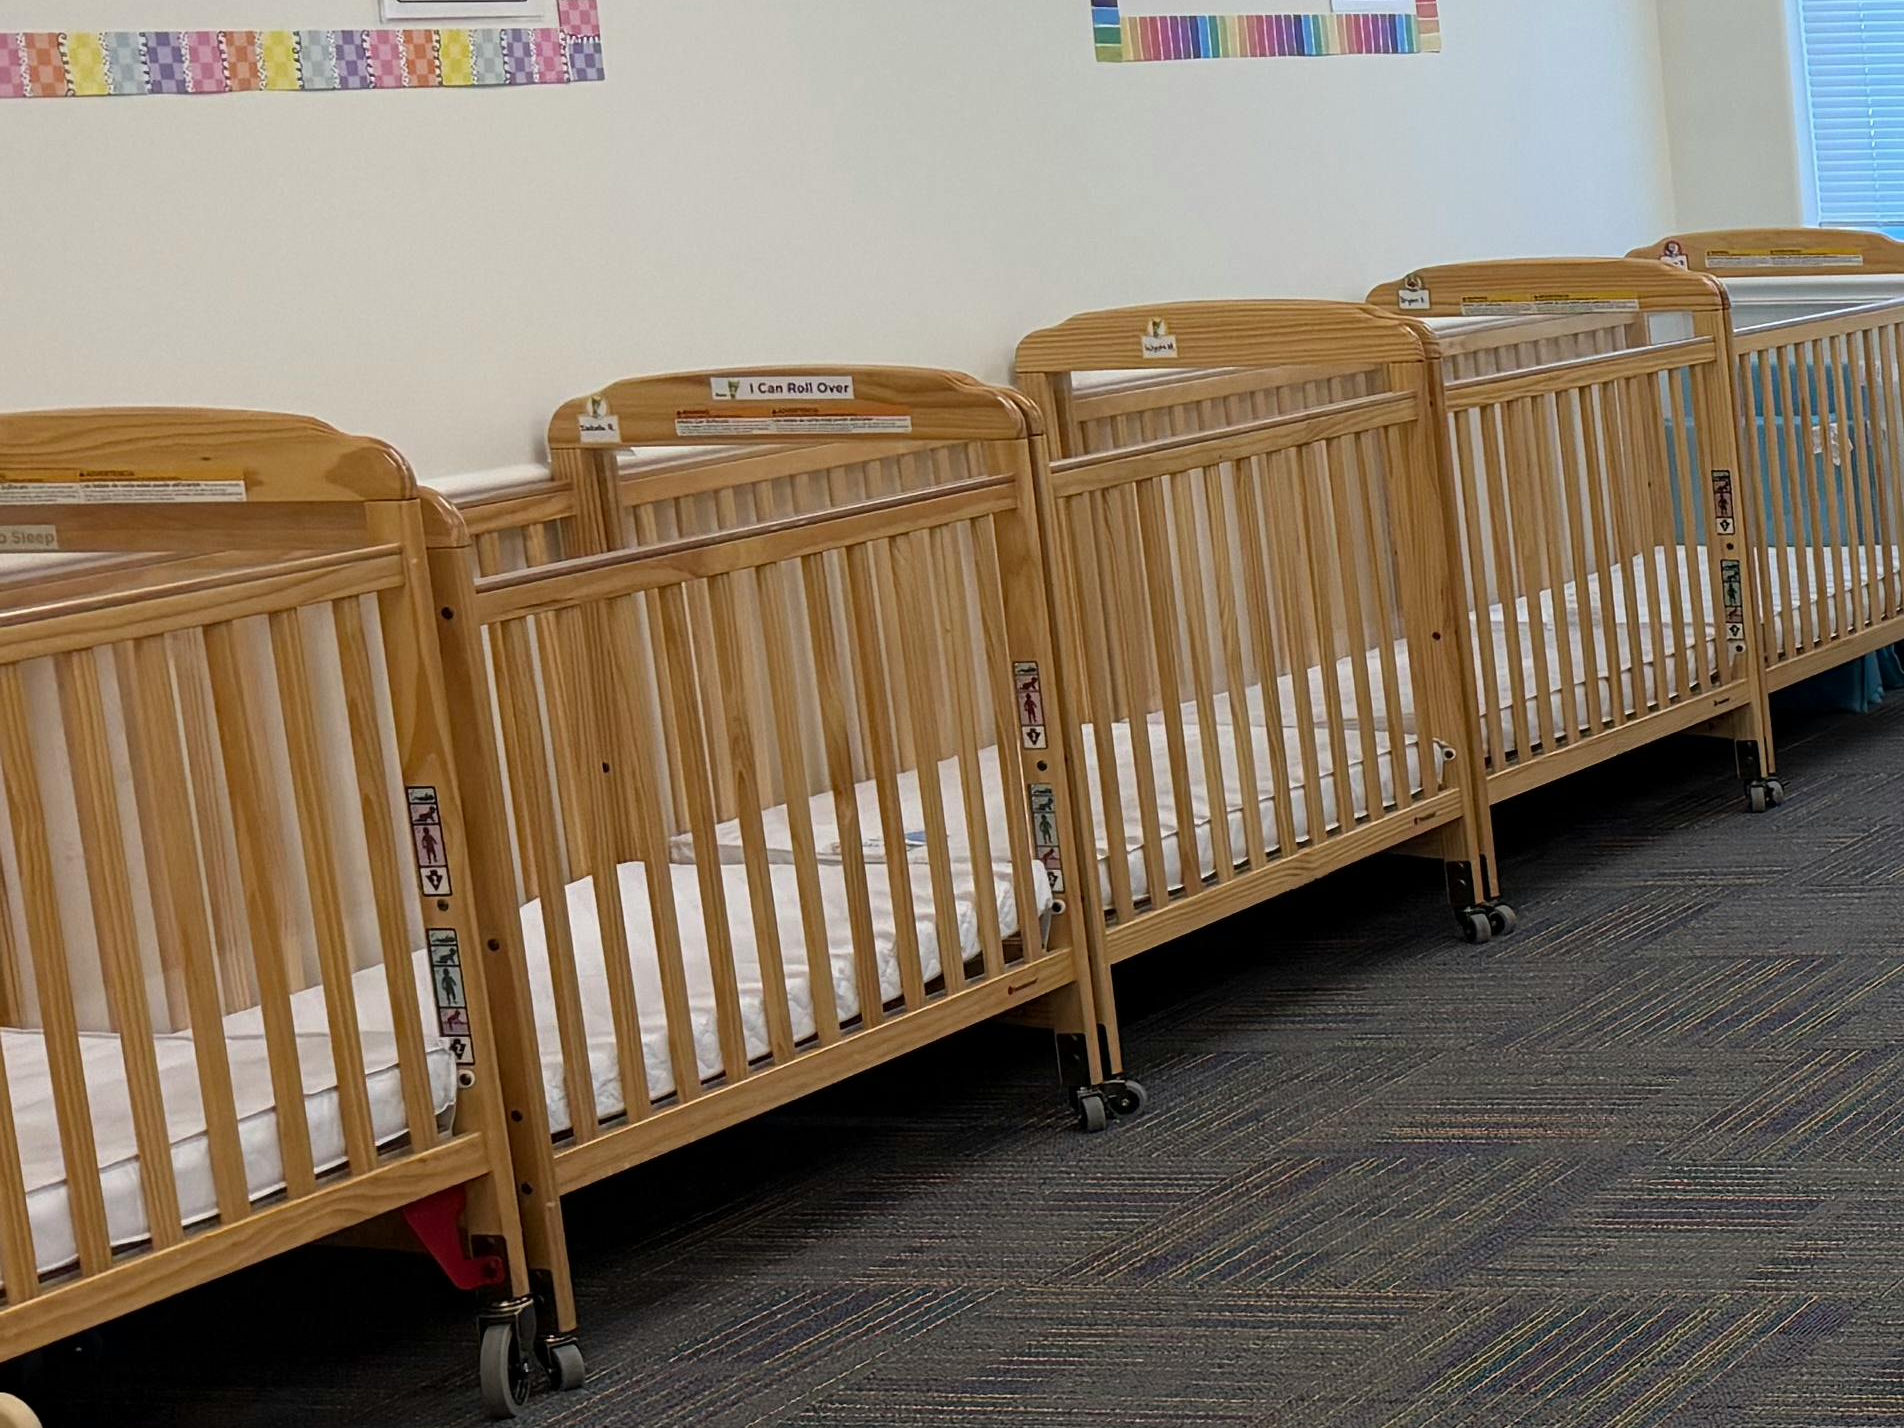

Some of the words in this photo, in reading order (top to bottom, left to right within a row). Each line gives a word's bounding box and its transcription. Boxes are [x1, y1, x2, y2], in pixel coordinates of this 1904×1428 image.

[758, 383, 783, 394] Can
[788, 382, 813, 394] Roll
[817, 382, 849, 394] Over
[12, 529, 55, 547] Sleep
